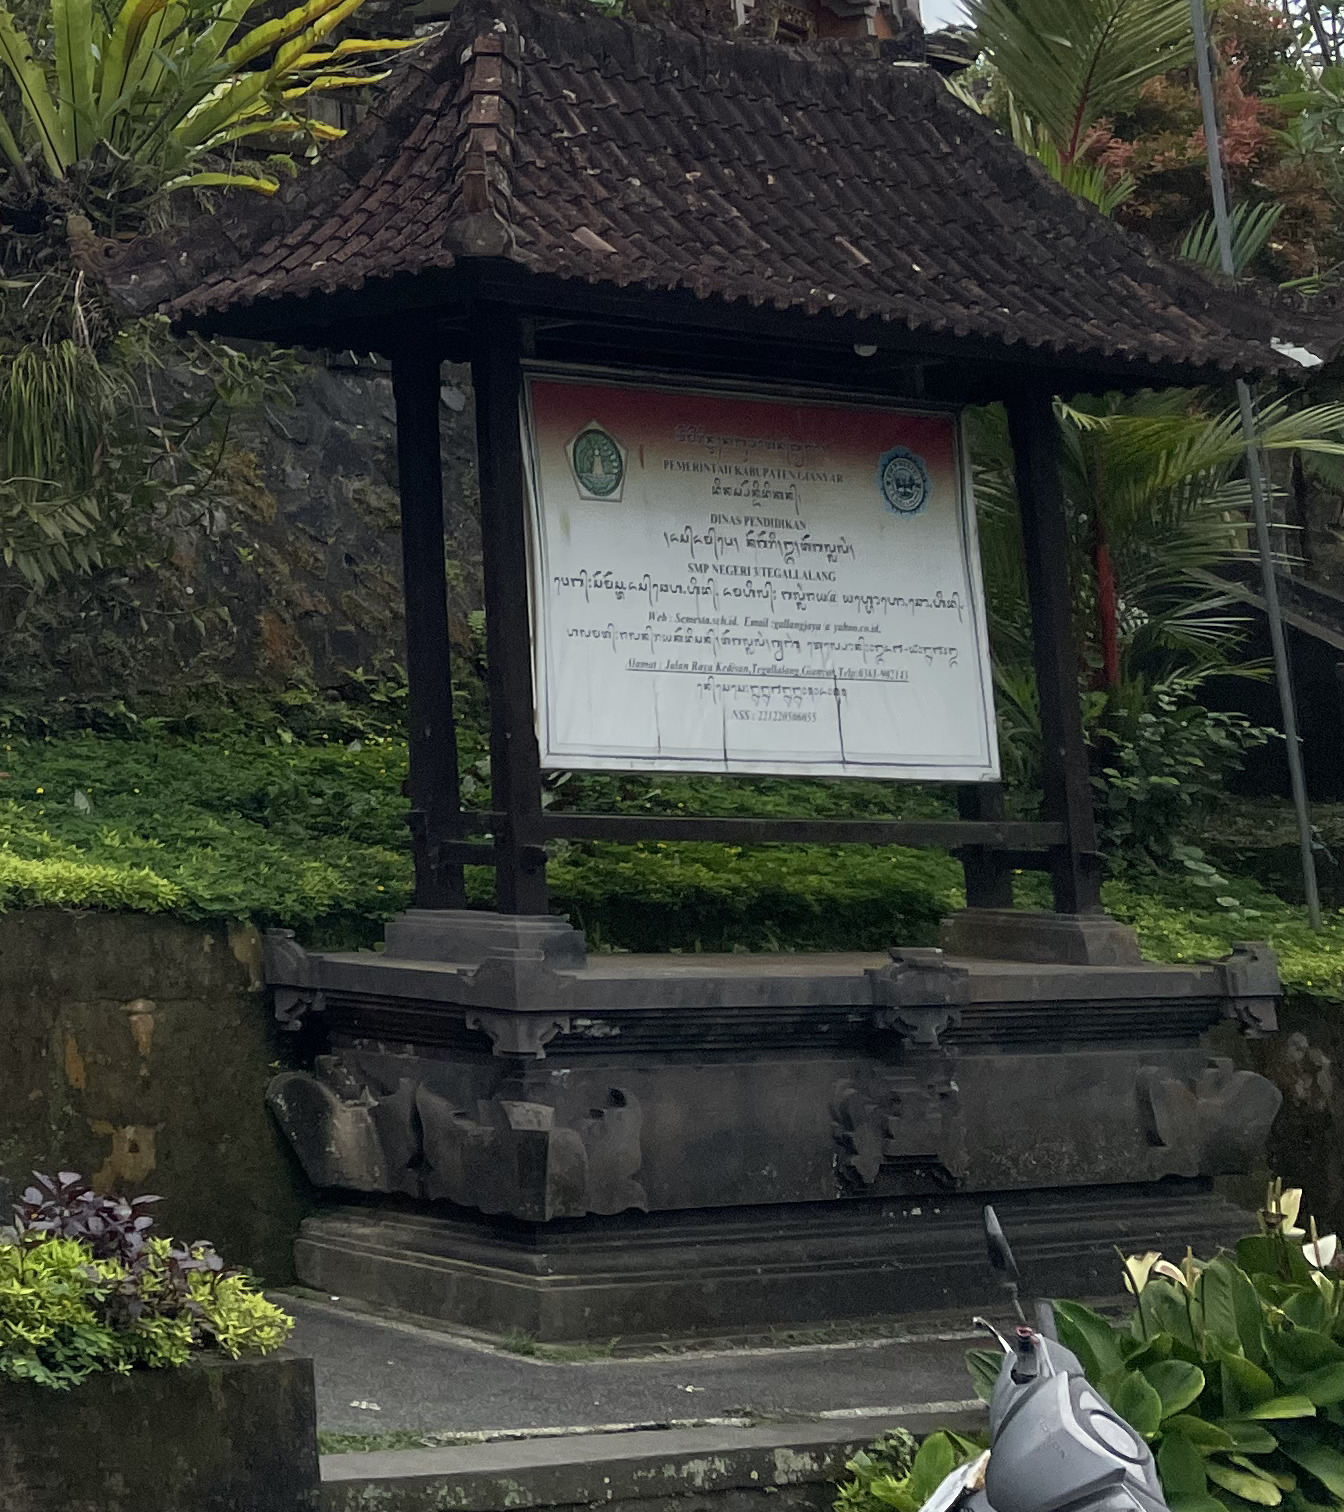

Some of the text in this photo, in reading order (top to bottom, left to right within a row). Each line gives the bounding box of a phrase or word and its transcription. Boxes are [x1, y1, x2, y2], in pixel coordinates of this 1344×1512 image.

[734, 464, 796, 481] KABUPATEN
[710, 513, 807, 531] DINAS PENDIDIKAN
[687, 562, 710, 574] SMP
[712, 563, 751, 577] NEGERI
[761, 566, 837, 583] TEGALLALANG
